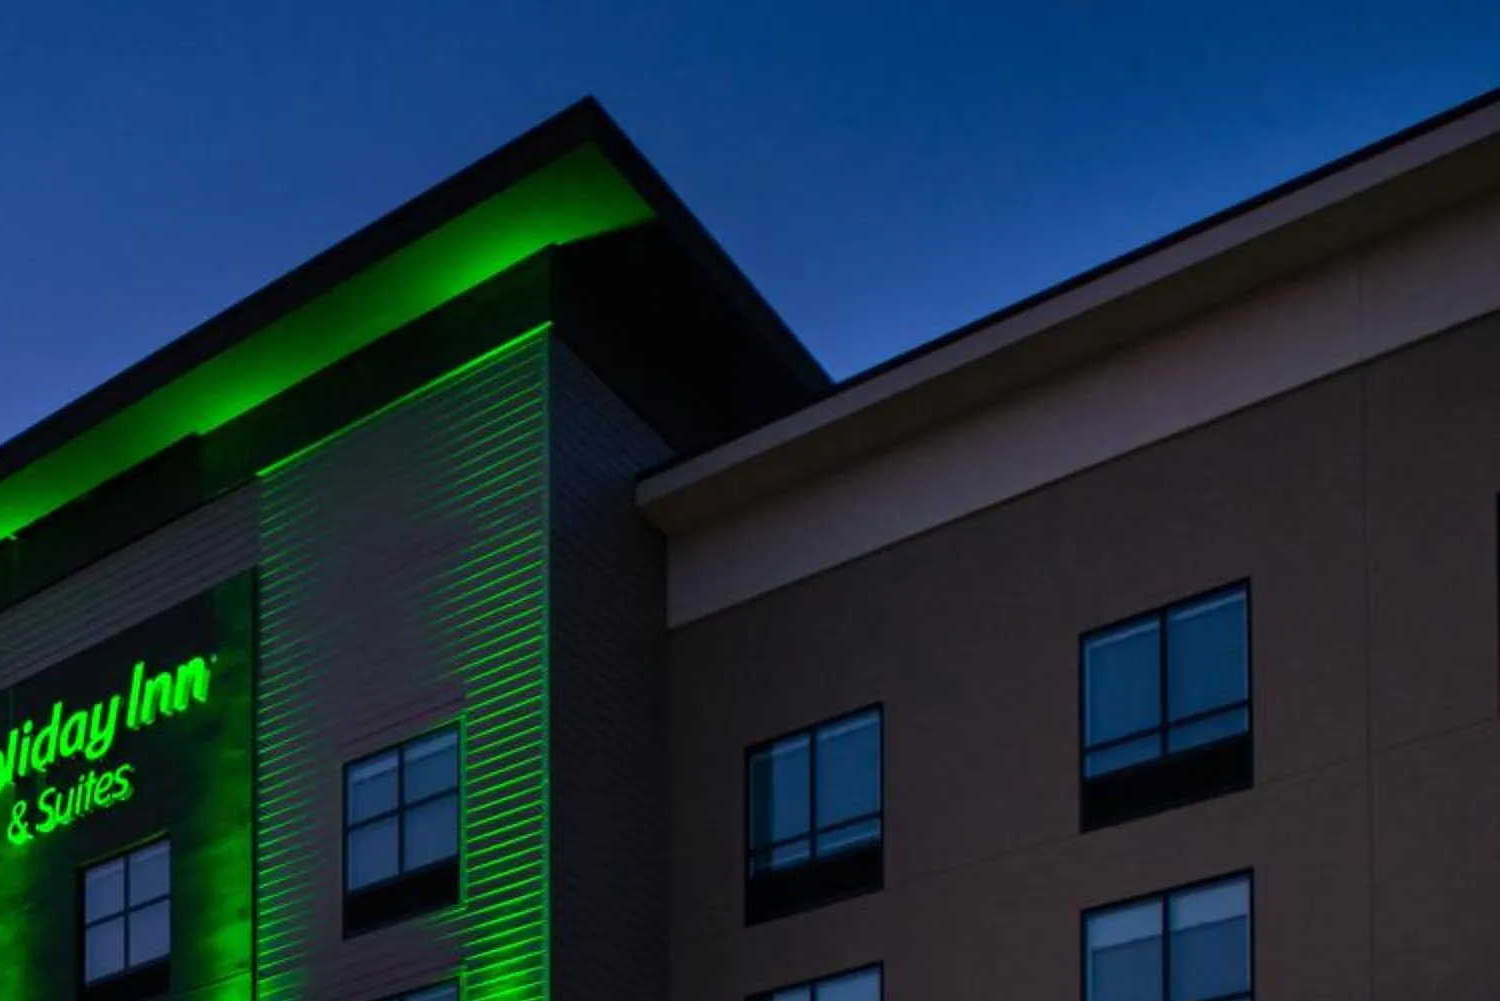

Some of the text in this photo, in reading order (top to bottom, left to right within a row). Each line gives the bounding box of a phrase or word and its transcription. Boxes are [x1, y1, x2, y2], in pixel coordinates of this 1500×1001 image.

[126, 657, 210, 730] Inn
[7, 763, 134, 844] & Suites
